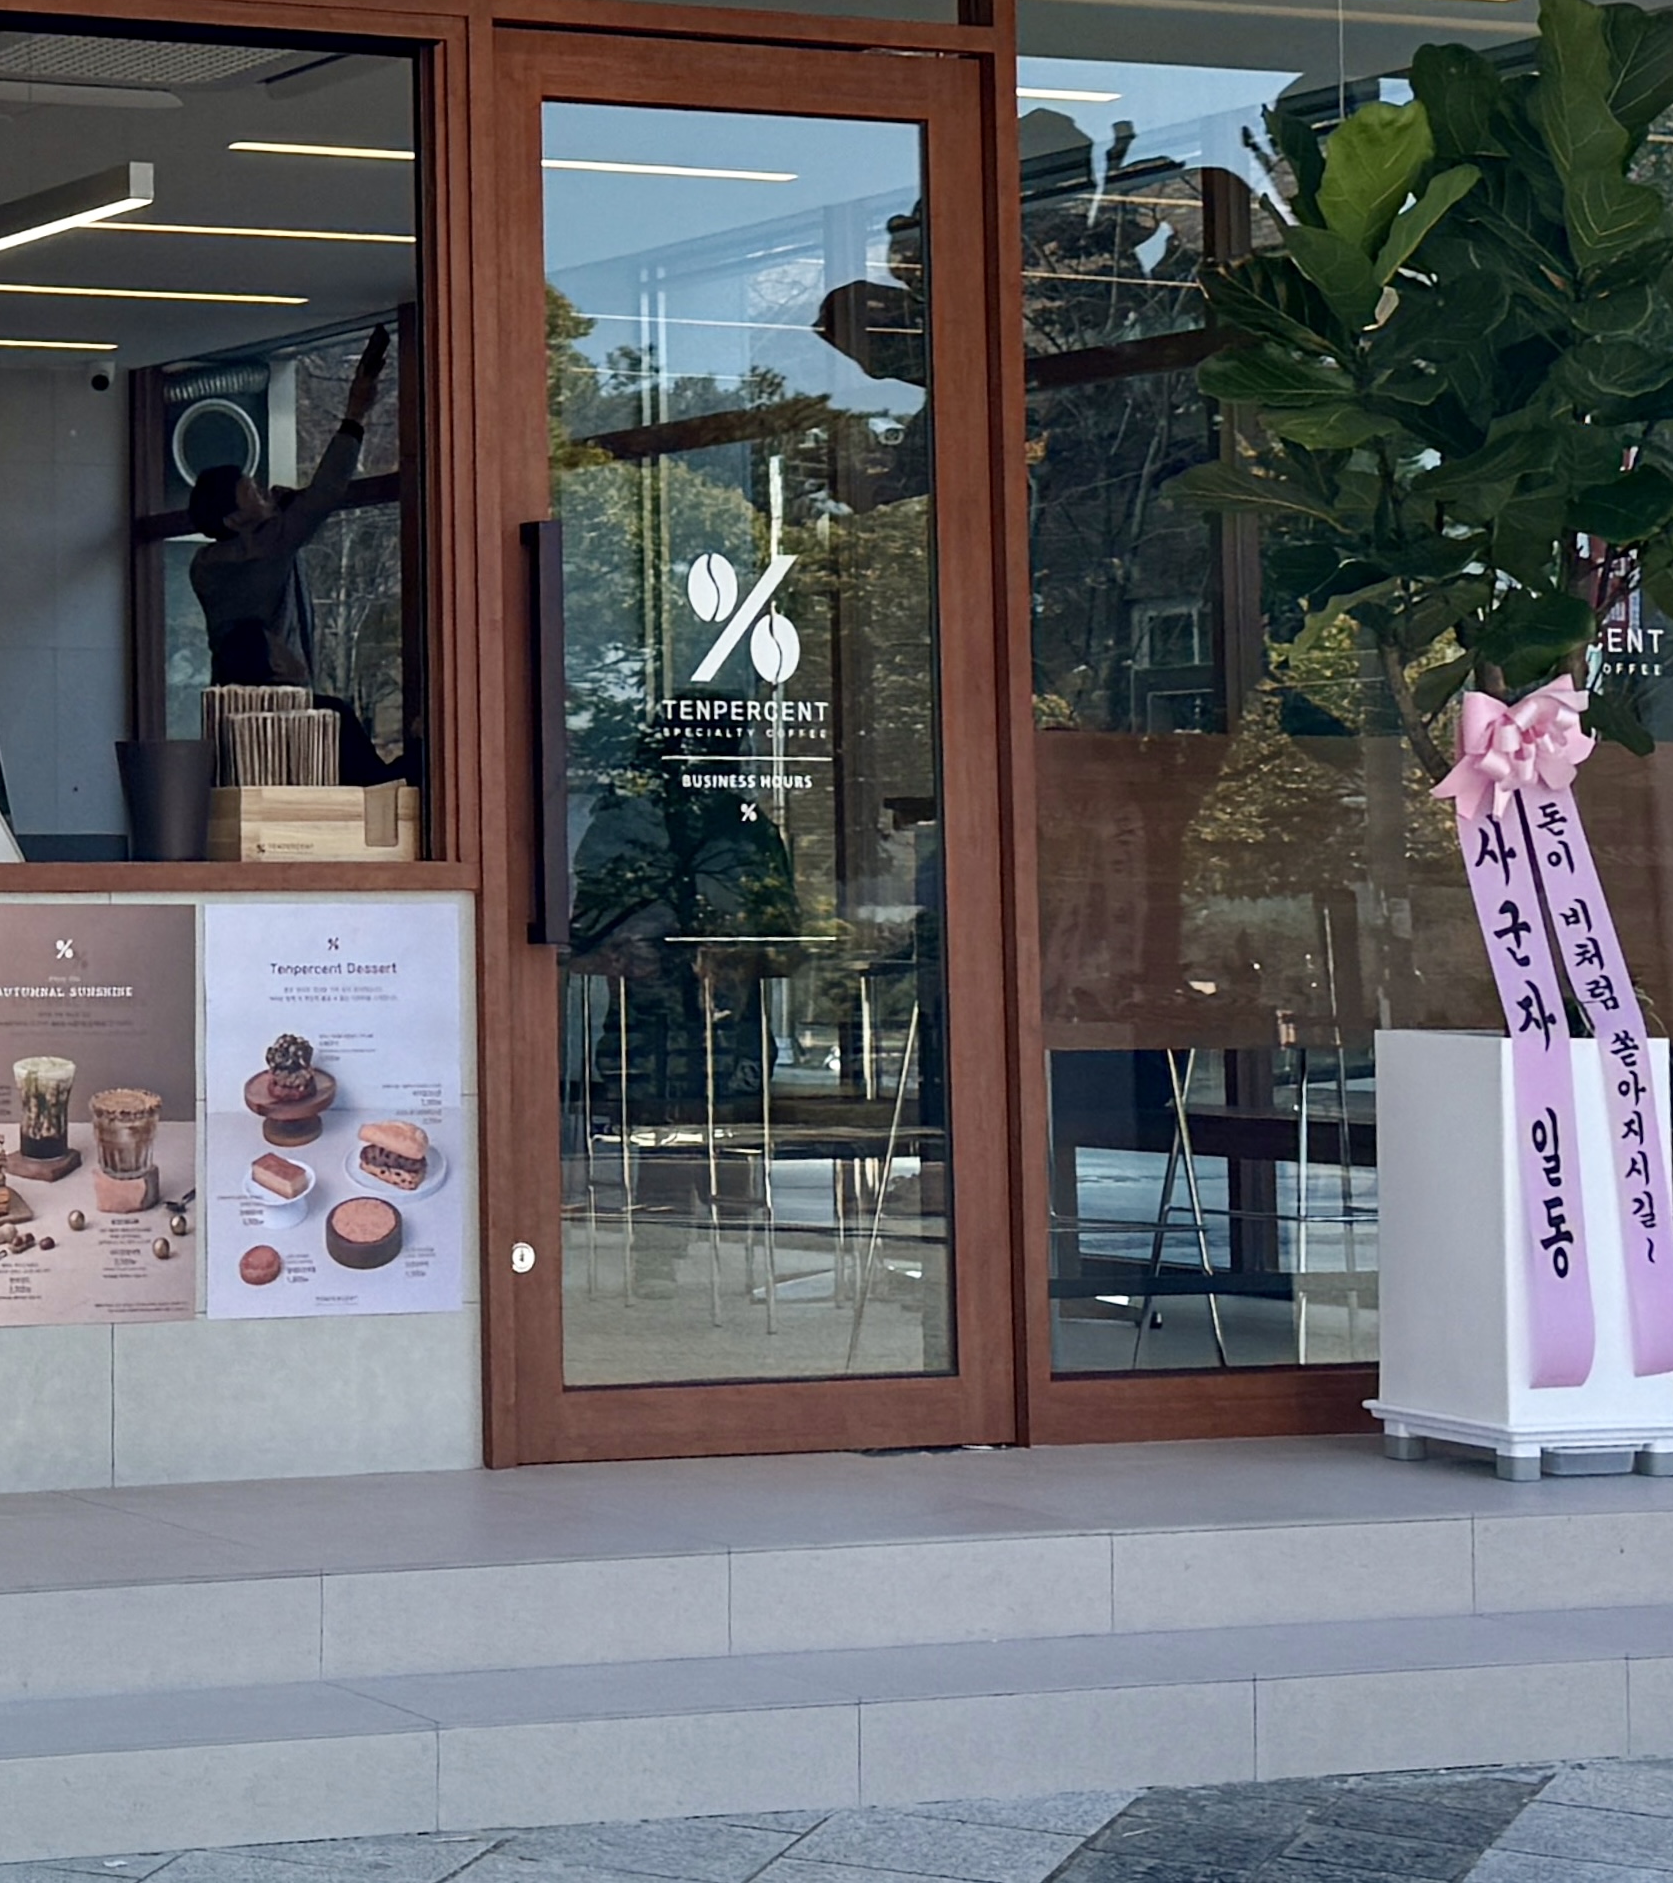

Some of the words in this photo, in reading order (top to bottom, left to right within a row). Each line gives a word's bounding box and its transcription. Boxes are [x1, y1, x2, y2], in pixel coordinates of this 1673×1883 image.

[1603, 662, 1662, 676] OFFEE
[662, 700, 829, 722] TENPERCENT
[662, 727, 755, 738] SPECIALTY
[766, 728, 827, 739] COFFEE
[682, 774, 756, 789] BUSINESS
[760, 775, 813, 789] HOURS
[1537, 802, 1575, 874] 돈이
[1559, 898, 1620, 1011] 비처럼
[270, 963, 342, 976] Tenpercent
[347, 962, 397, 975] Dessert
[69, 986, 133, 998] SUNSHINE
[1475, 814, 1557, 1052] 사군자
[1531, 1107, 1574, 1278] 일동
